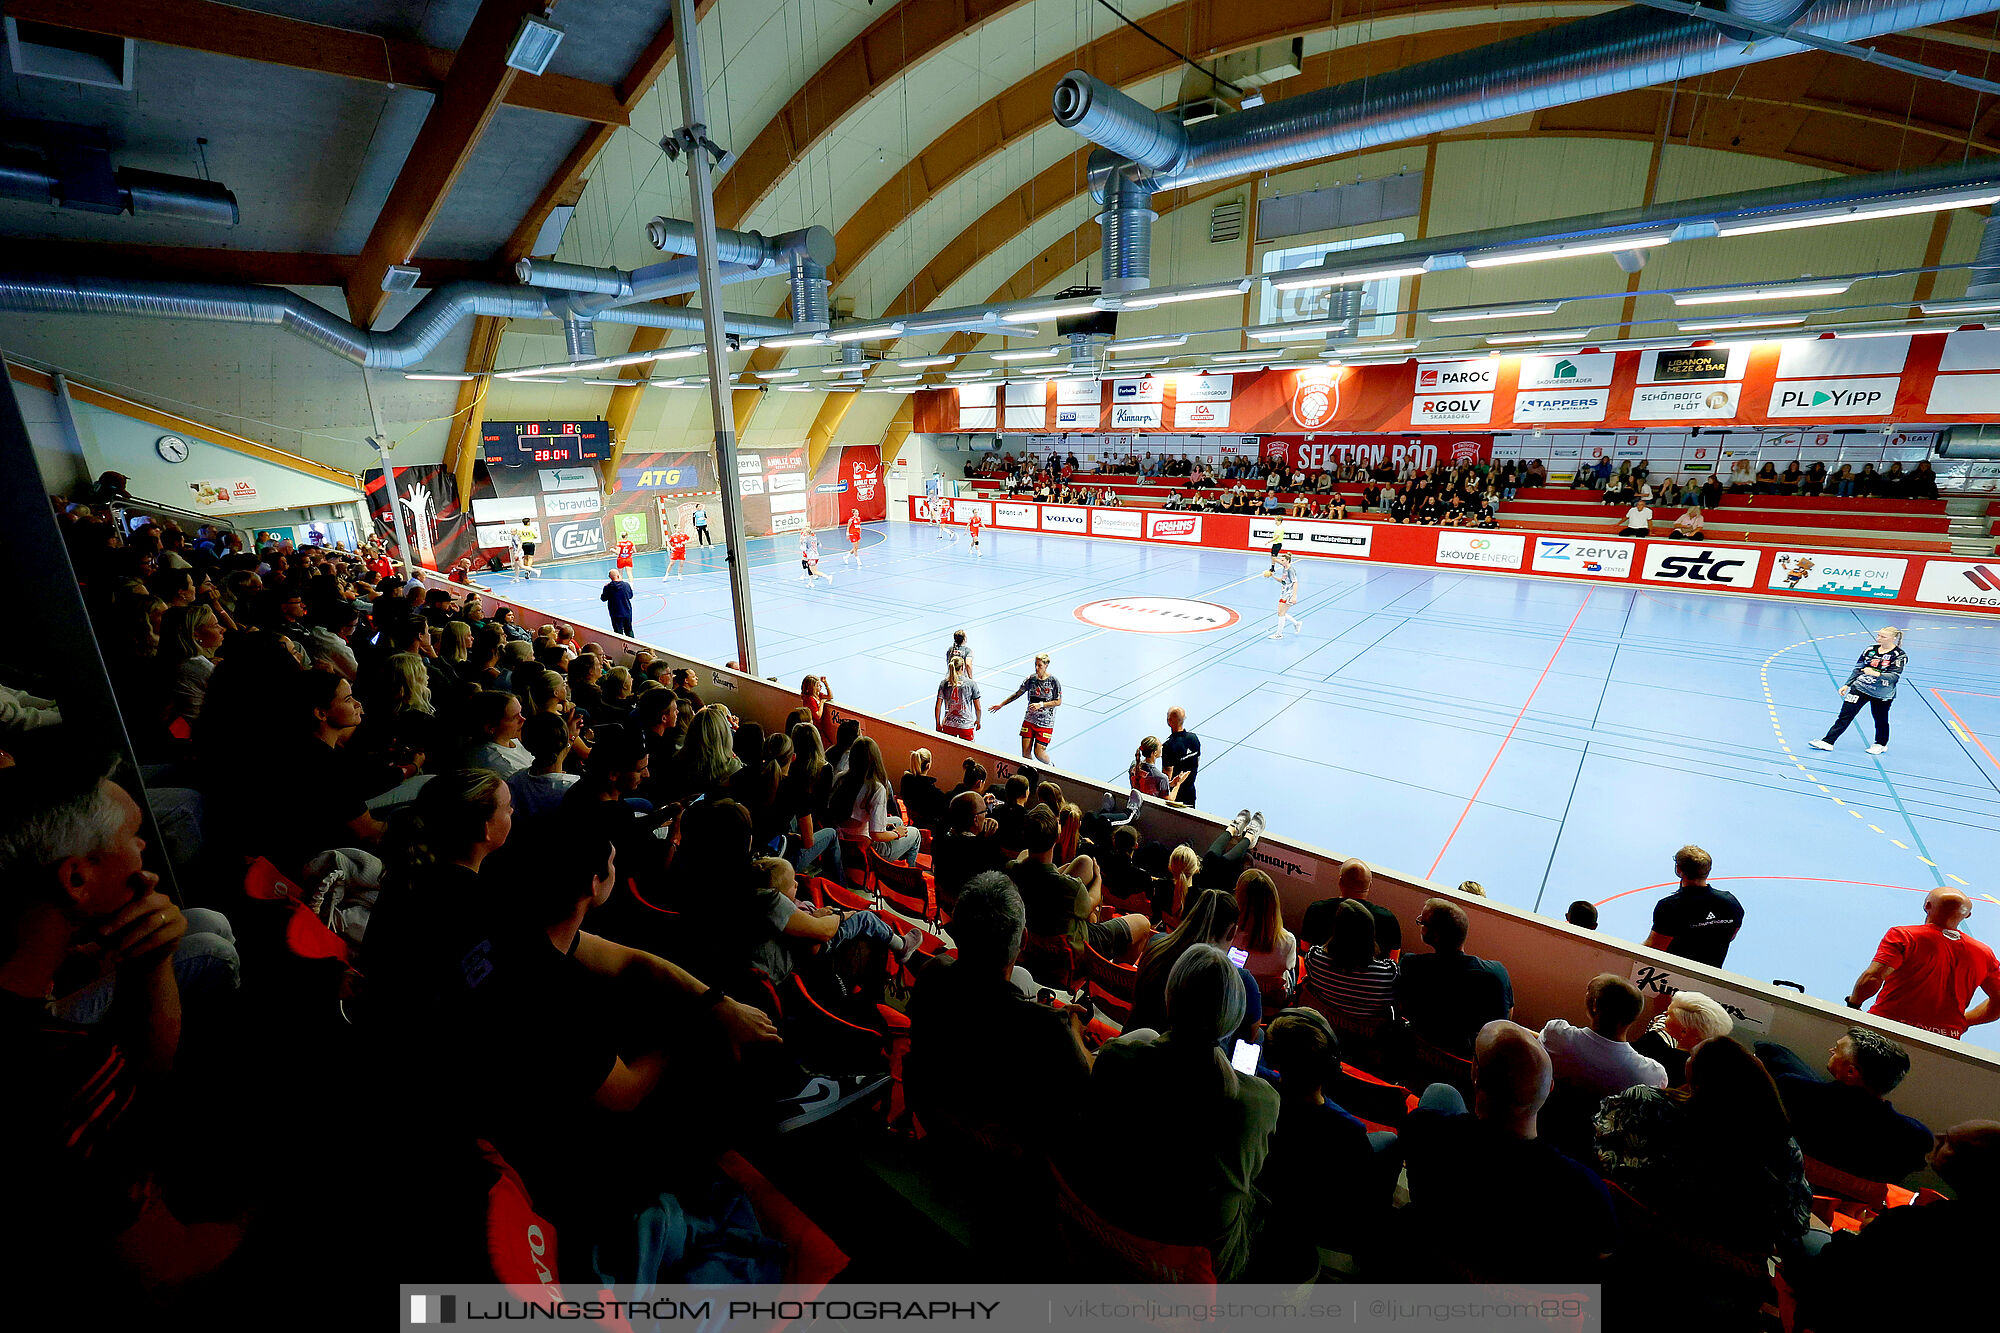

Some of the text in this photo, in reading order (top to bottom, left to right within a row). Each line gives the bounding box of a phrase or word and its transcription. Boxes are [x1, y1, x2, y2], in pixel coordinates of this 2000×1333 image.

[1668, 358, 1711, 367] LIBANON
[1695, 364, 1704, 372] &
[1705, 363, 1725, 371] BAR
[1442, 372, 1489, 384] PAROC
[1195, 405, 1209, 413] ICA
[1423, 400, 1481, 412] RGOLV
[515, 424, 581, 435] H 10 12 G
[1298, 444, 1388, 470] SEKTION
[1392, 440, 1438, 471] RÖD
[637, 469, 680, 486] ATG
[559, 497, 598, 510] bravida
[775, 516, 800, 527] redo
[1046, 515, 1083, 524] VOLVO
[1440, 550, 1519, 564] SKÖVDE ENERGI
[1575, 547, 1628, 560] zerva
[1655, 550, 1744, 583] stc
[1822, 567, 1889, 579] GAME ON!
[1252, 847, 1312, 875] innarps
